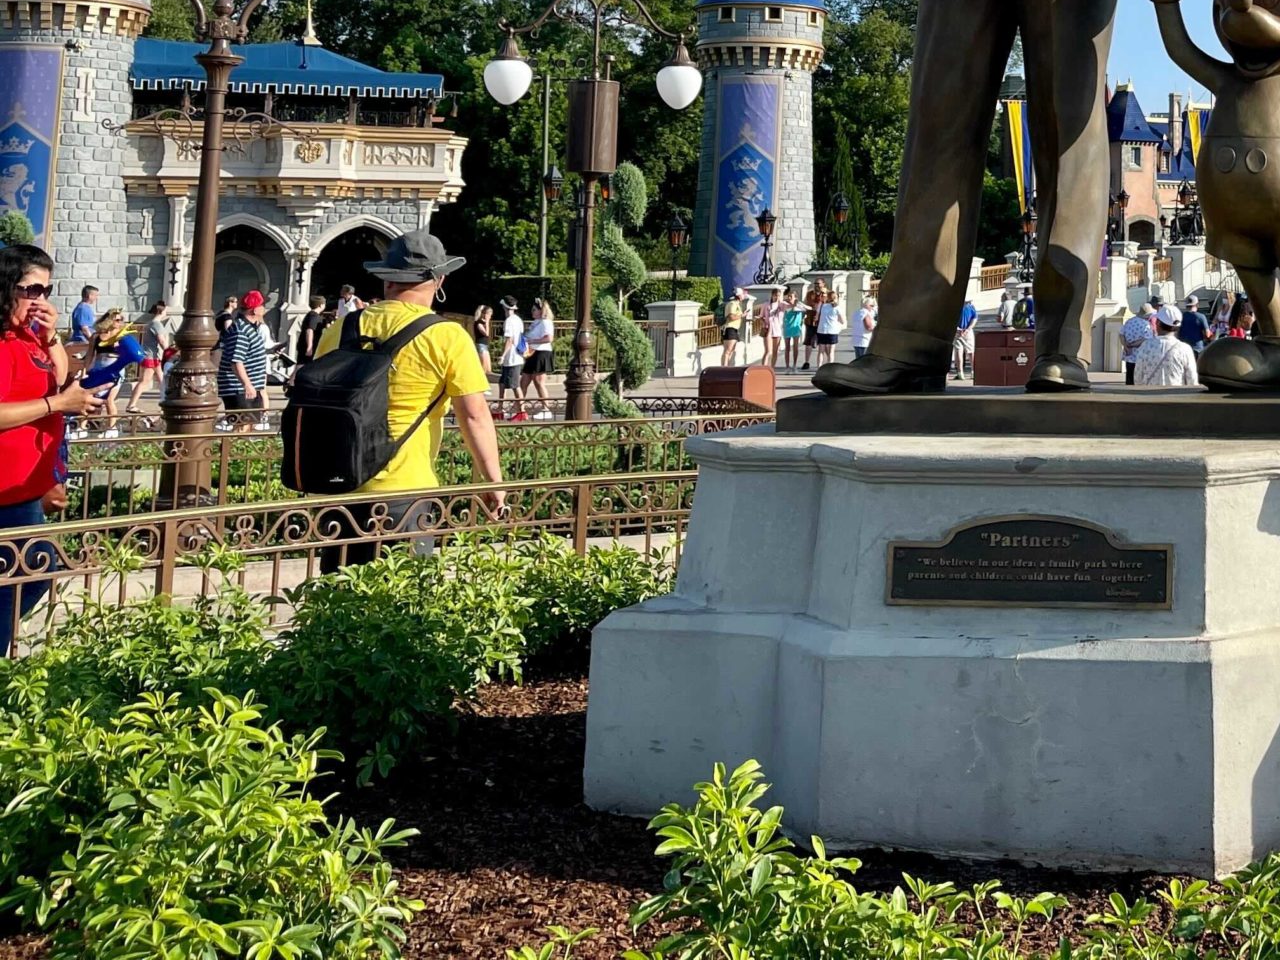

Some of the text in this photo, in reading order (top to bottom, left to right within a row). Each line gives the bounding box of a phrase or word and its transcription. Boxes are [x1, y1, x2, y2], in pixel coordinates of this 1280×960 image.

[939, 558, 976, 566] believe
[1048, 559, 1080, 569] family
[1084, 559, 1108, 570] park
[1111, 560, 1143, 568] where
[907, 572, 945, 581] parents
[948, 572, 967, 580] and
[1016, 573, 1043, 581] could
[1047, 573, 1070, 581] have
[1073, 573, 1091, 581] fun
